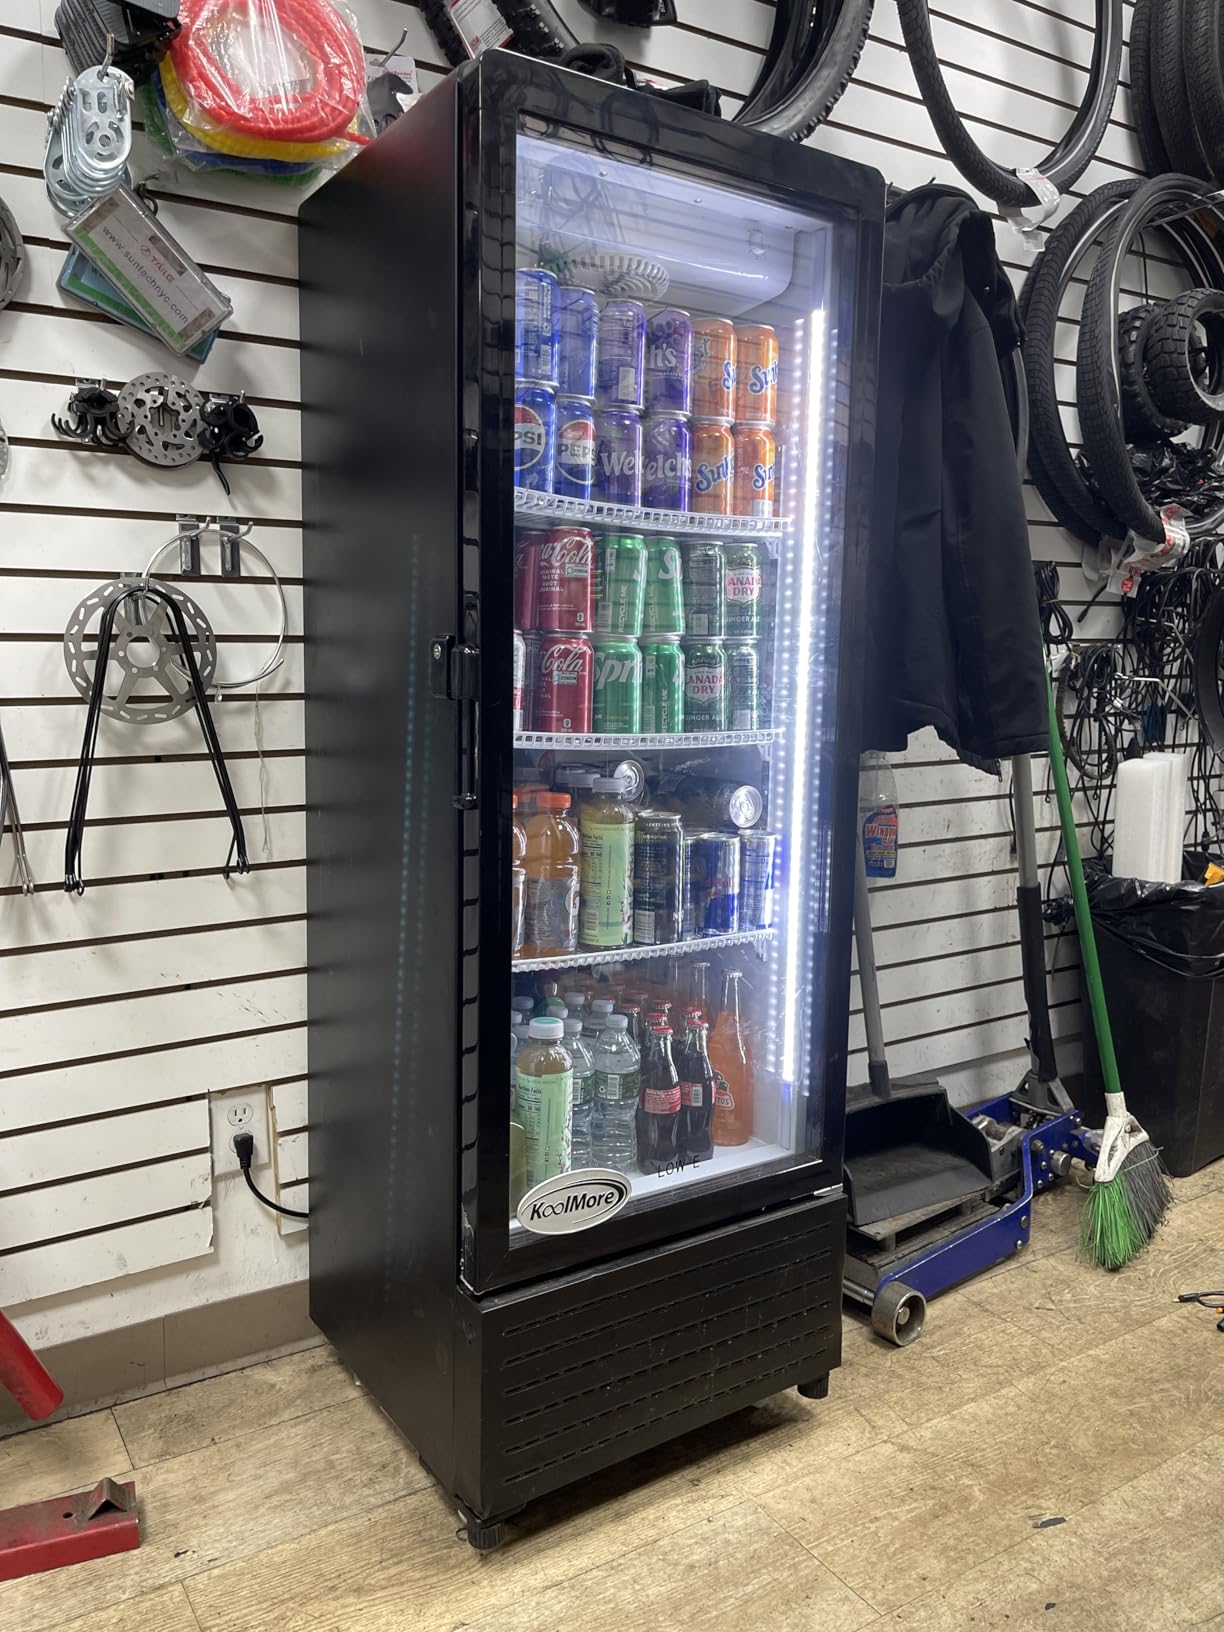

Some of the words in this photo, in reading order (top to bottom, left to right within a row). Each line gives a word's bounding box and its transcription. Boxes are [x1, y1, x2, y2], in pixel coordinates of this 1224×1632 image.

[102, 226, 189, 323] www.suntechnyc.com
[541, 644, 592, 673] Cola
[692, 685, 716, 694] DRY
[530, 1190, 615, 1221] KoolMore
